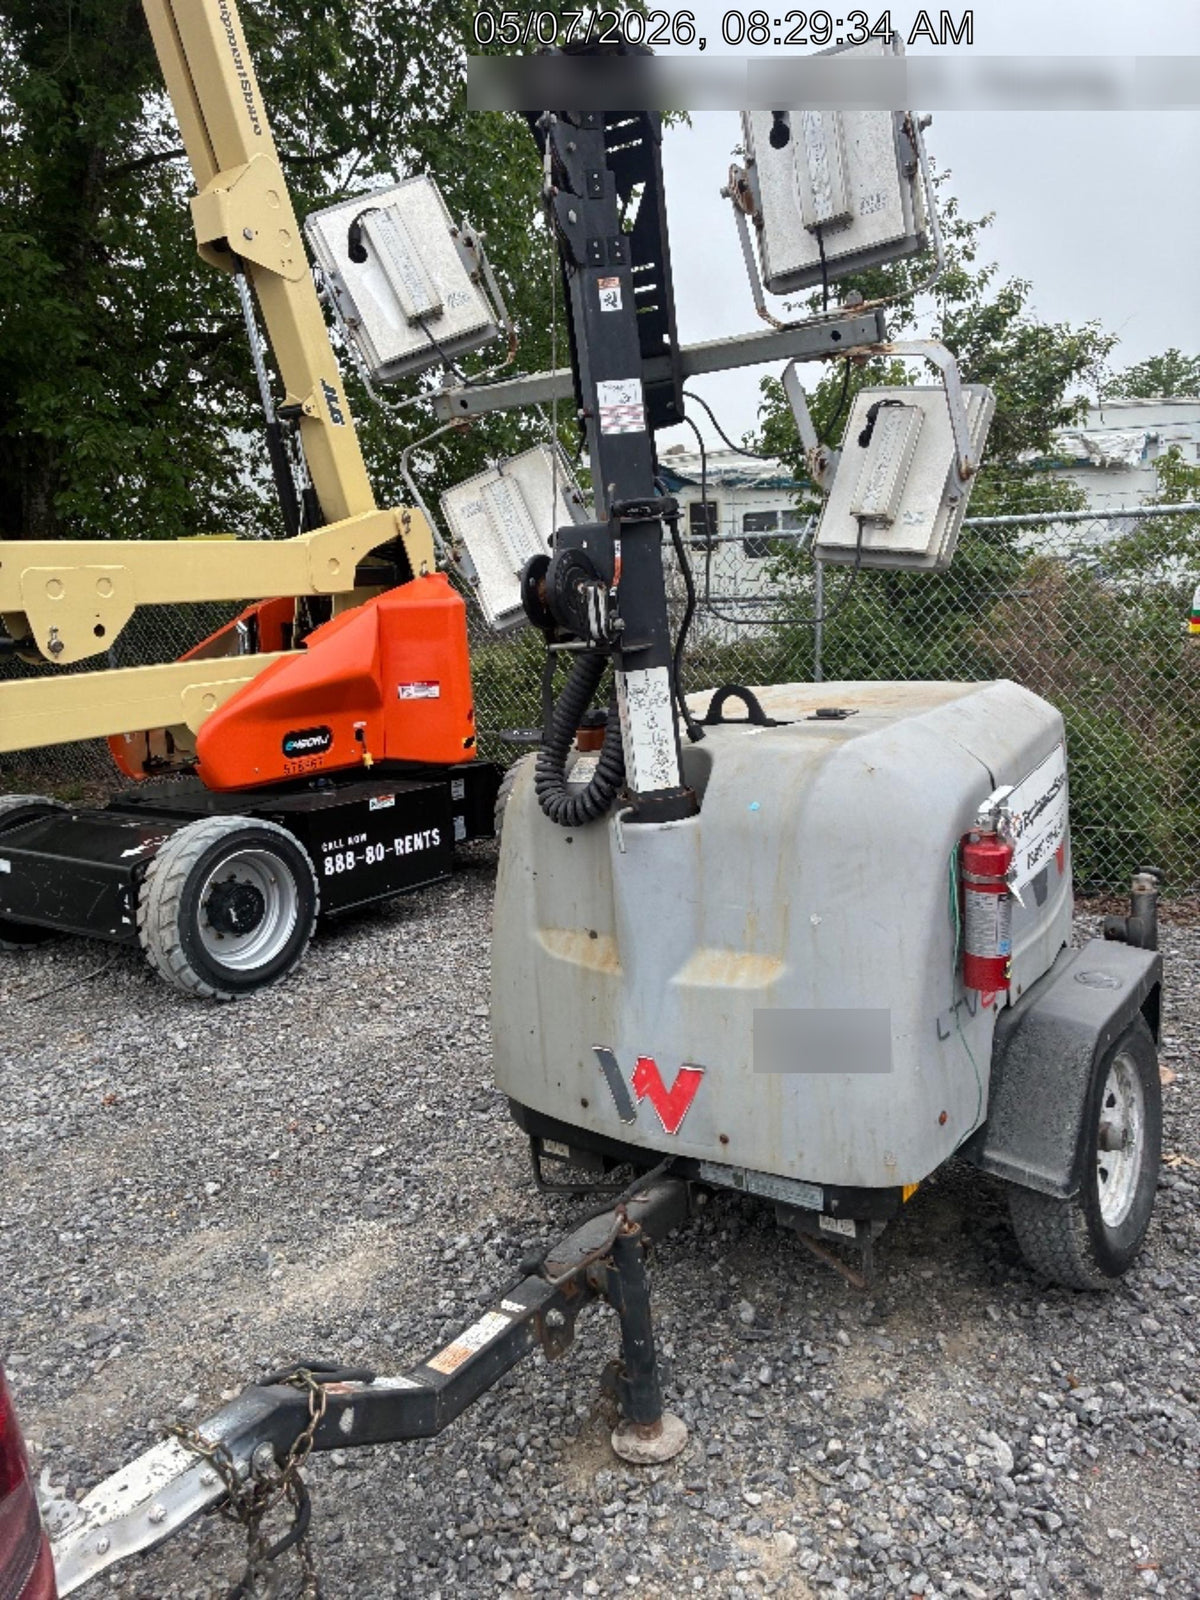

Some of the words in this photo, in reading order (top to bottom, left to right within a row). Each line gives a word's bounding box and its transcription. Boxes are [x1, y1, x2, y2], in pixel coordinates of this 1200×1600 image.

[319, 378, 345, 425] JLG
[321, 837, 345, 853] CALL
[347, 832, 367, 846] NOW
[323, 828, 441, 876] 888-80-RENTS
